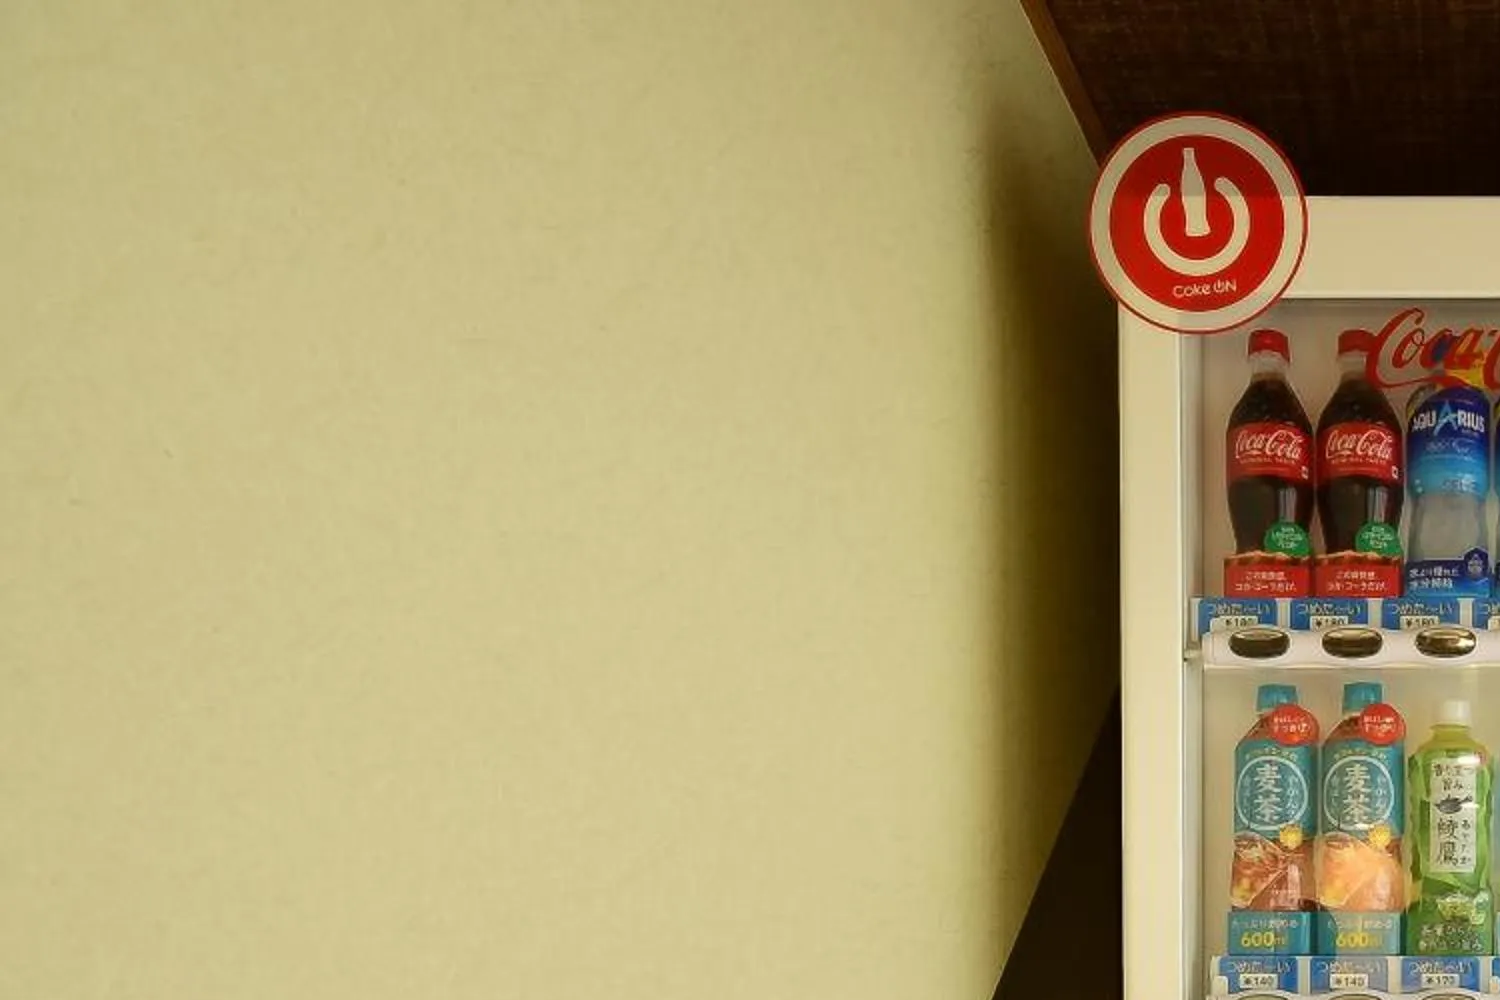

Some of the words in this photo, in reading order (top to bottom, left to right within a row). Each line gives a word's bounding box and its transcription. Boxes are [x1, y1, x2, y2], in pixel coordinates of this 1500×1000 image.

[1172, 283, 1211, 298] Coke
[1213, 280, 1237, 293] ON
[1412, 400, 1485, 436] AQUARIUS
[1235, 429, 1304, 459] Coca-Cola
[1325, 429, 1393, 459] Coca-Cola
[1254, 763, 1282, 823] 麦茶
[1343, 763, 1372, 824] 麦茶
